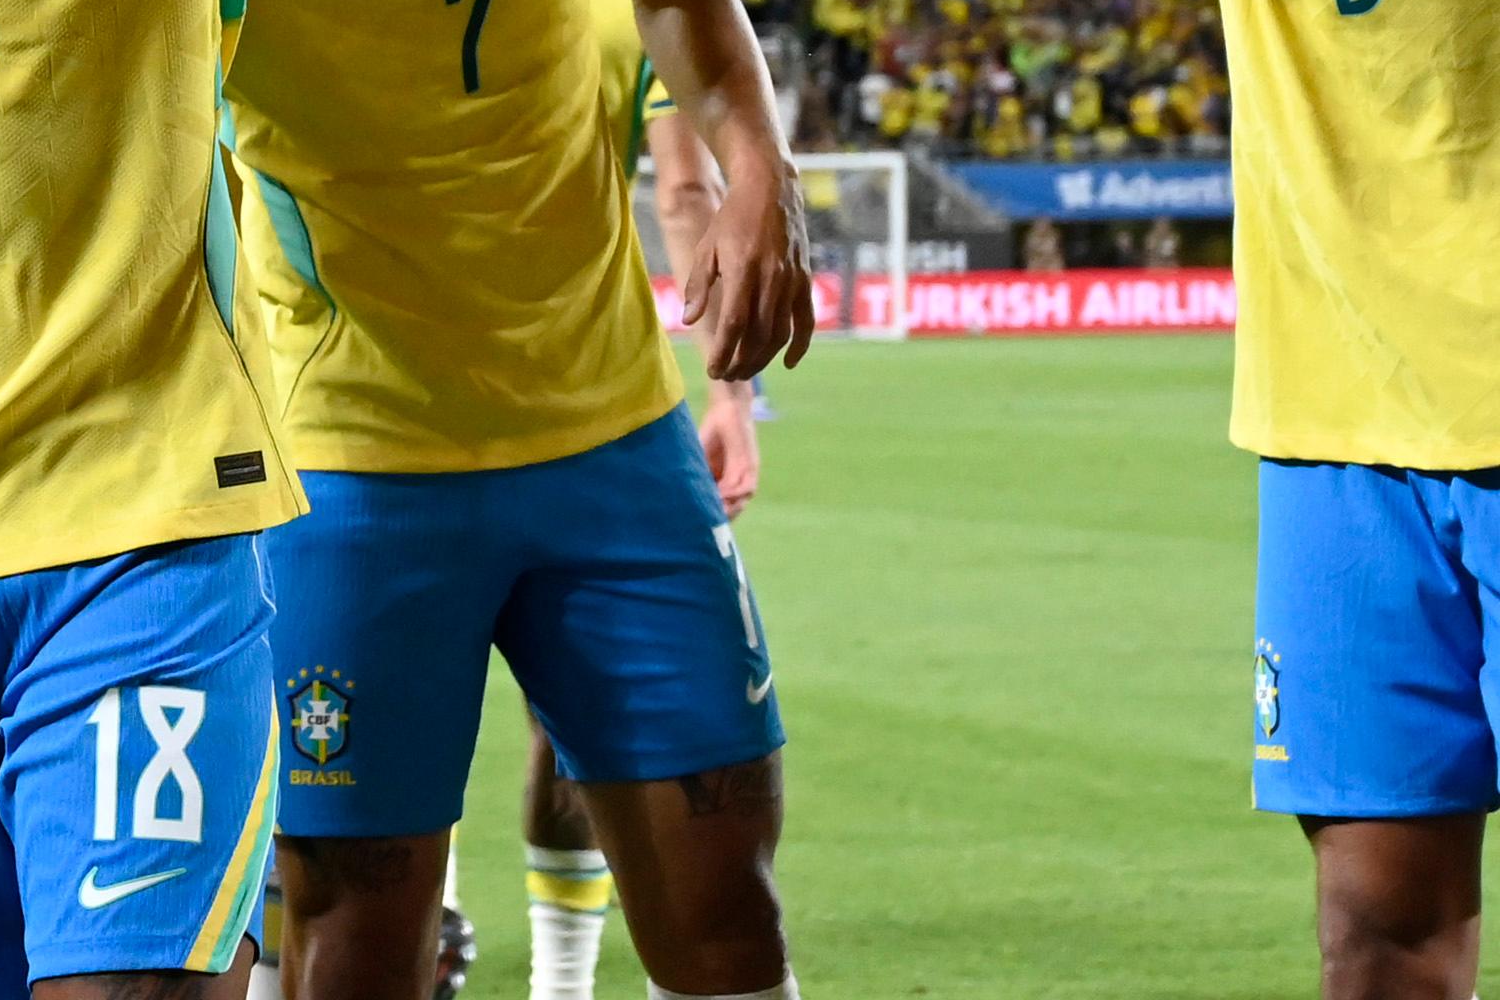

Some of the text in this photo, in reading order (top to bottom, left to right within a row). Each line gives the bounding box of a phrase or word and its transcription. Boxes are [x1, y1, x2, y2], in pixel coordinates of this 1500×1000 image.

[1100, 170, 1234, 209] Advent
[306, 714, 332, 726] CBF
[85, 685, 207, 844] 18
[289, 769, 357, 785] BRASIL
